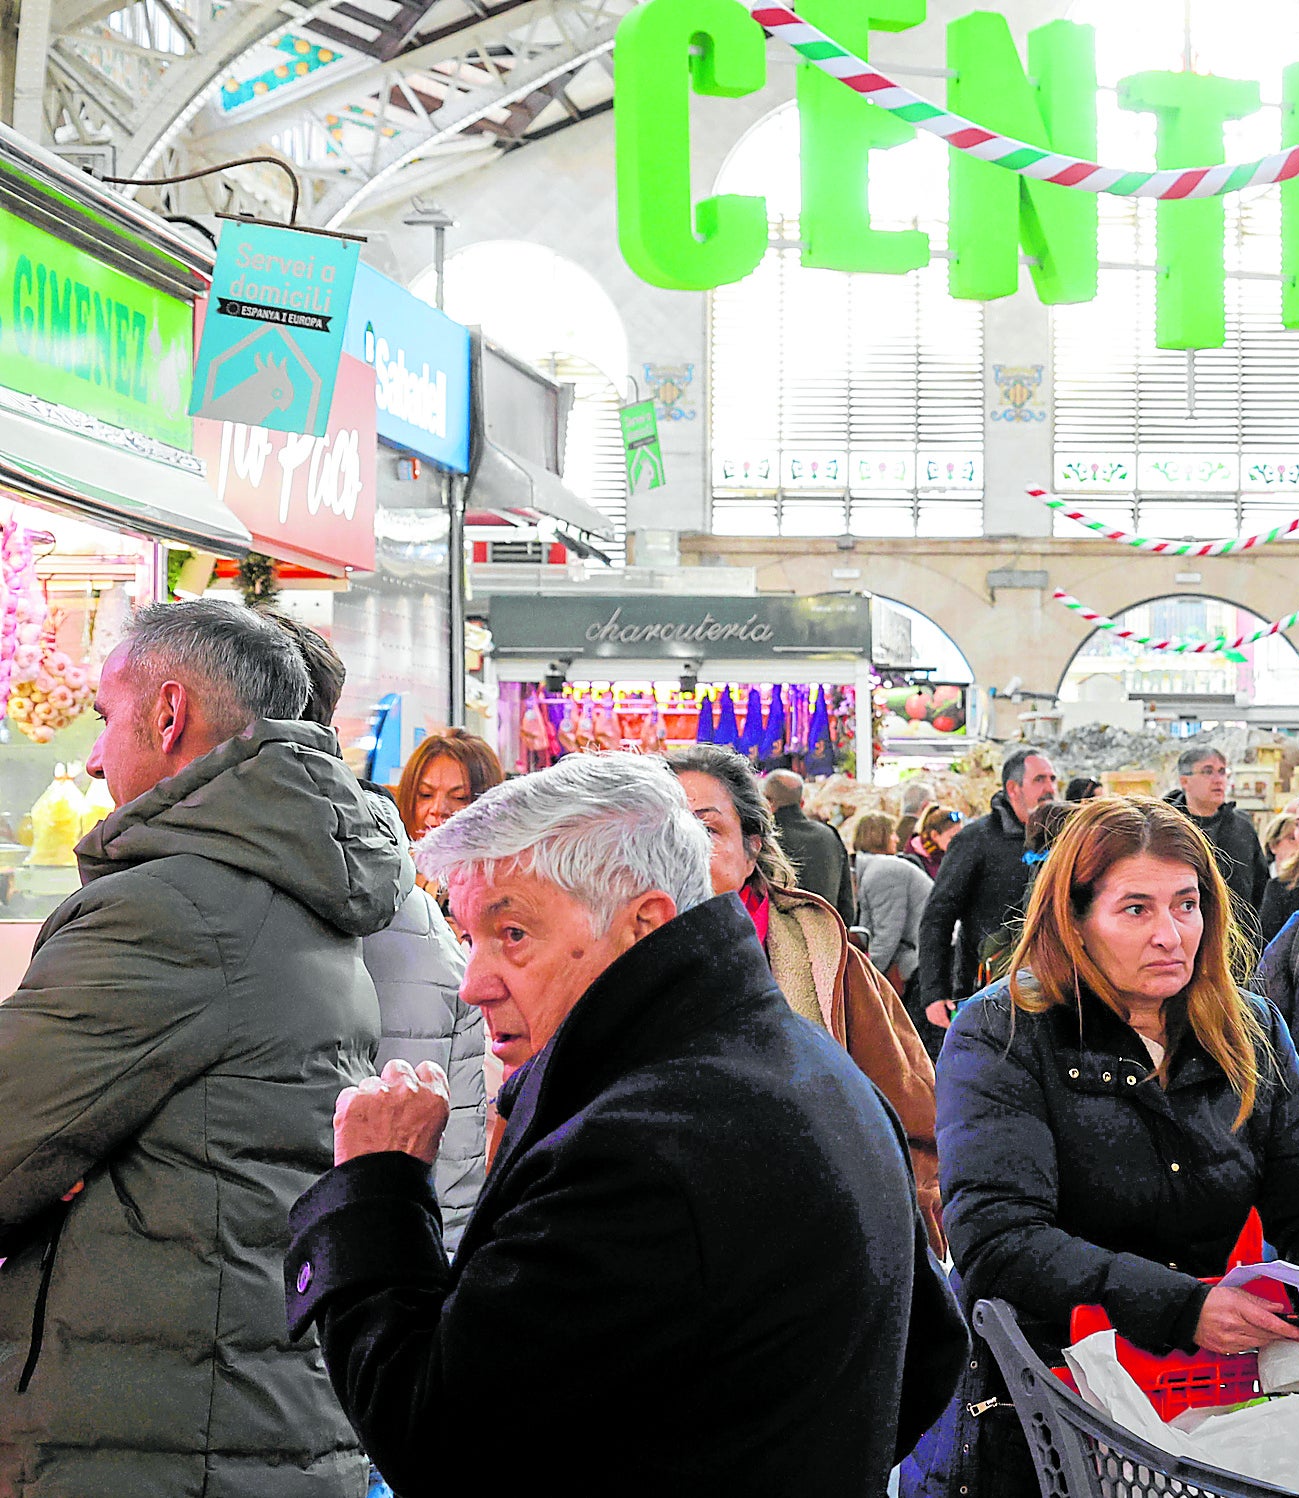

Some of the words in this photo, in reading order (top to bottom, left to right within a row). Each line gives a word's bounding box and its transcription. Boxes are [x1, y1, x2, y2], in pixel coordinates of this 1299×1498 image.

[236, 242, 316, 279] Servei
[320, 265, 336, 283] a
[230, 273, 333, 313] domicili
[13, 254, 148, 404] GIMENEZ
[241, 304, 281, 321] ESPANYA
[288, 313, 323, 328] EUROPA
[585, 607, 774, 643] charcutería
